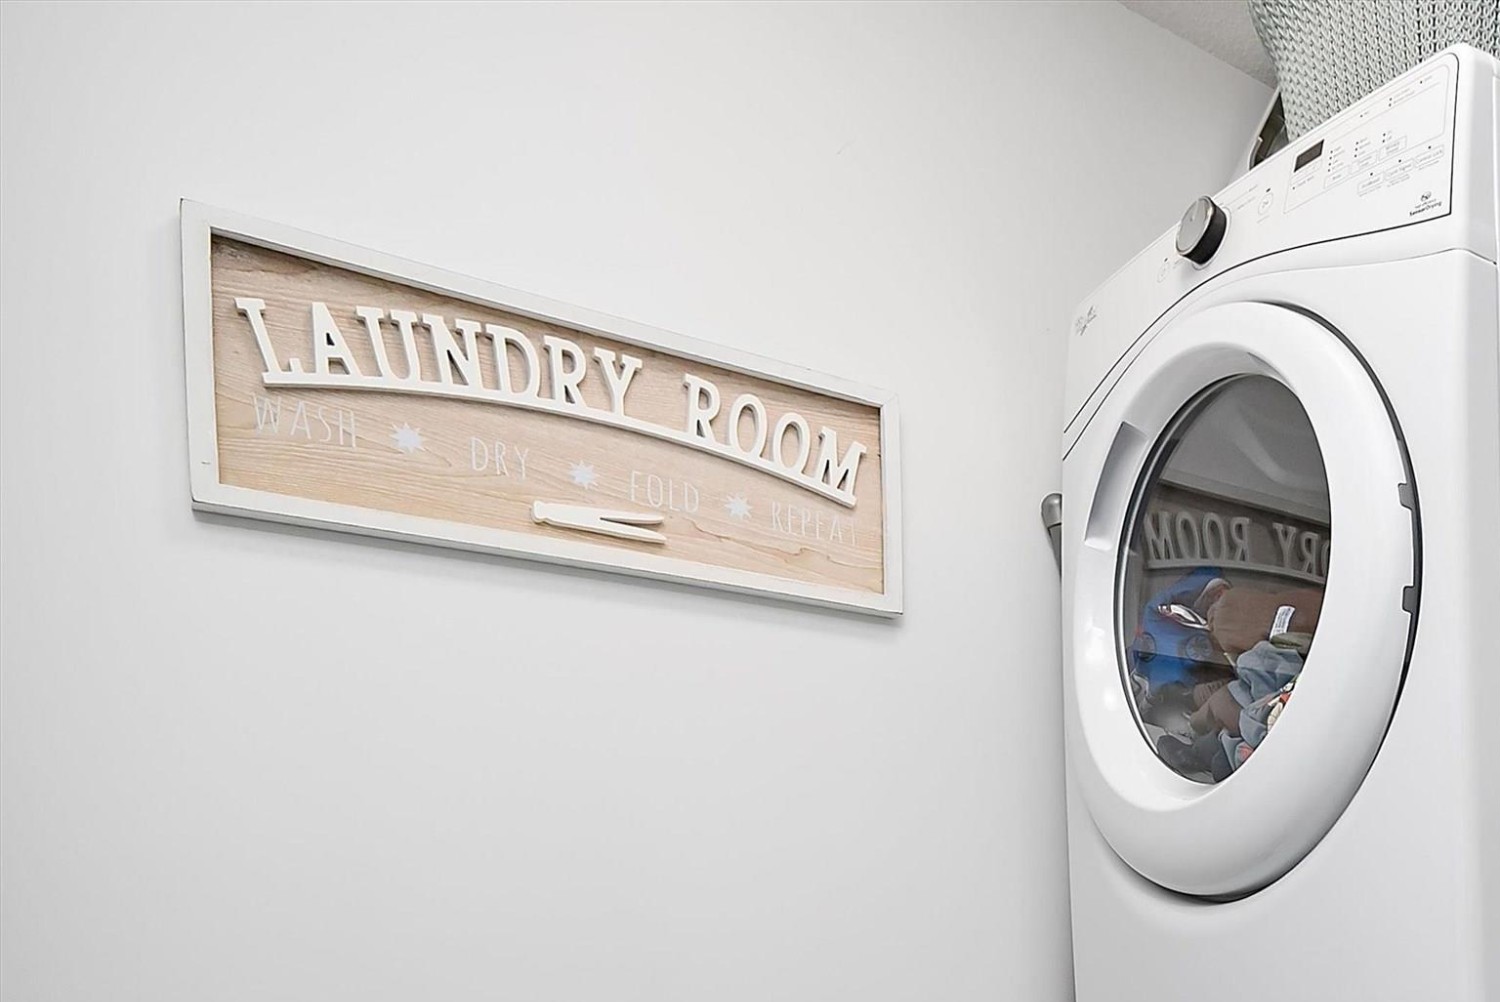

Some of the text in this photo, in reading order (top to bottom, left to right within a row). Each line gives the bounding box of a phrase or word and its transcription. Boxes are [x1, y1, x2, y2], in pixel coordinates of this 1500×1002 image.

[234, 298, 867, 498] LAUNDRY ROOM
[252, 391, 357, 449] WASH
[470, 437, 529, 480] DRY
[630, 470, 699, 513] FOLD
